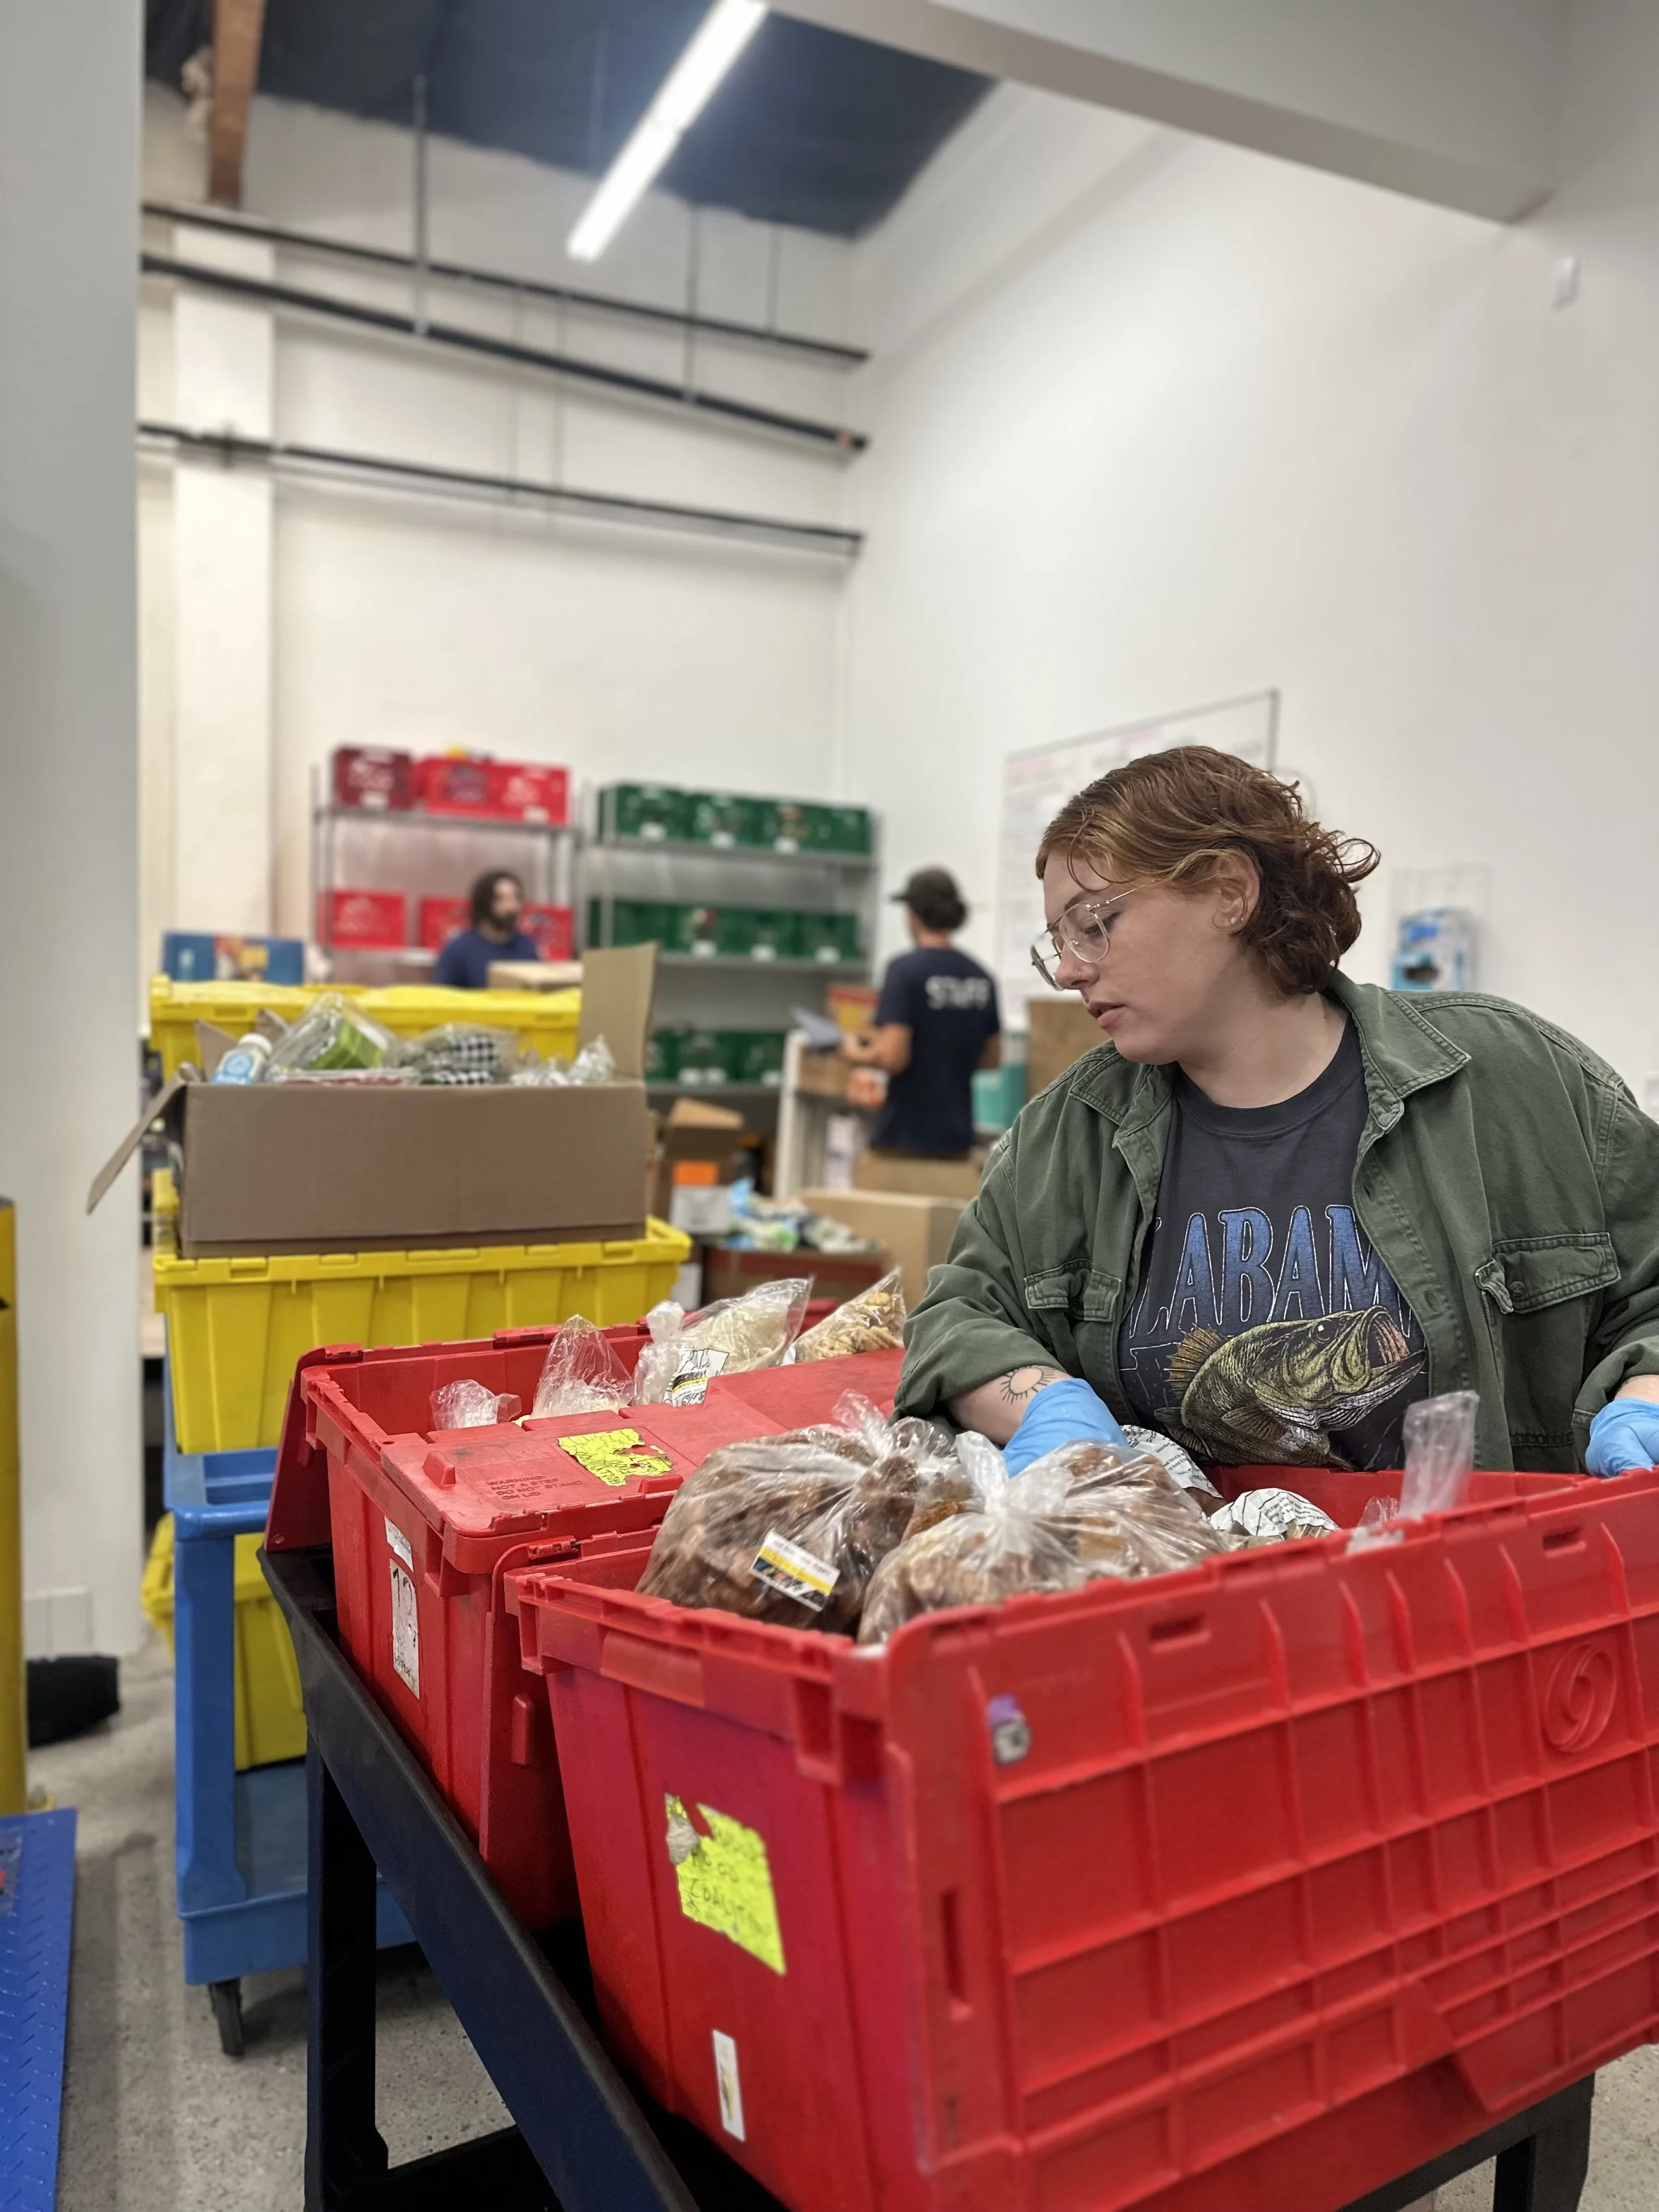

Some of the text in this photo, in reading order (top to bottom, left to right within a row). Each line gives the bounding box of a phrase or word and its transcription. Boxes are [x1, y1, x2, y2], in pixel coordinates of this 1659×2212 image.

[1129, 1205, 1415, 1338] LABAM
[487, 1475, 546, 1486] WARNING:
[544, 1480, 583, 1489] STAND
